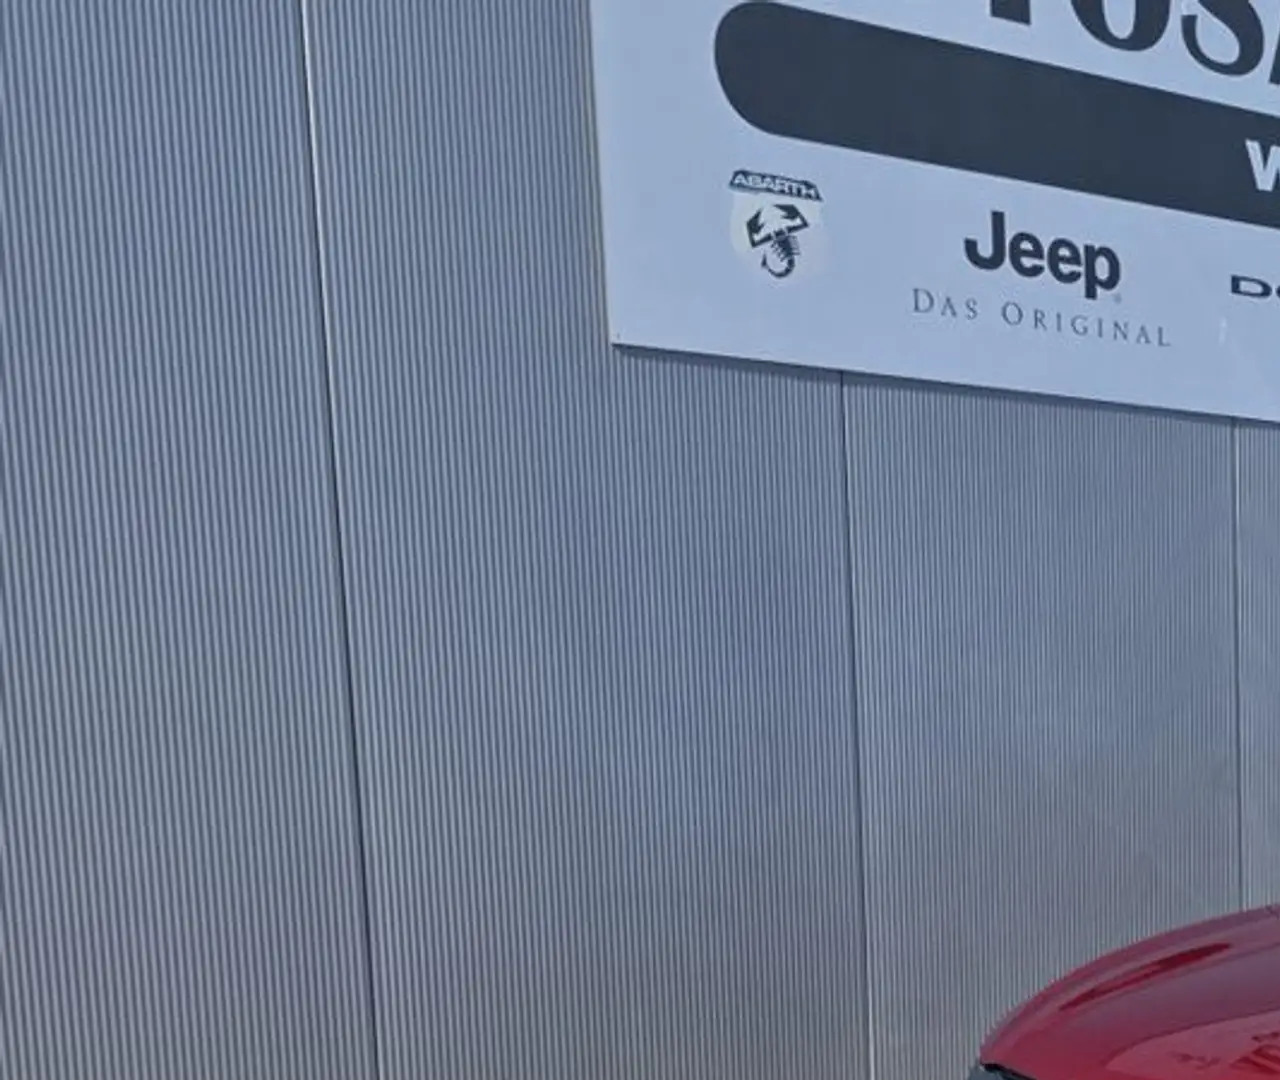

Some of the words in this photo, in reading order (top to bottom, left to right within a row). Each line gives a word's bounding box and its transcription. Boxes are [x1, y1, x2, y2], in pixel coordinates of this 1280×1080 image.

[732, 171, 819, 199] ABARTH
[964, 210, 1121, 300] Jeep
[1002, 301, 1171, 347] ORIGINAL
